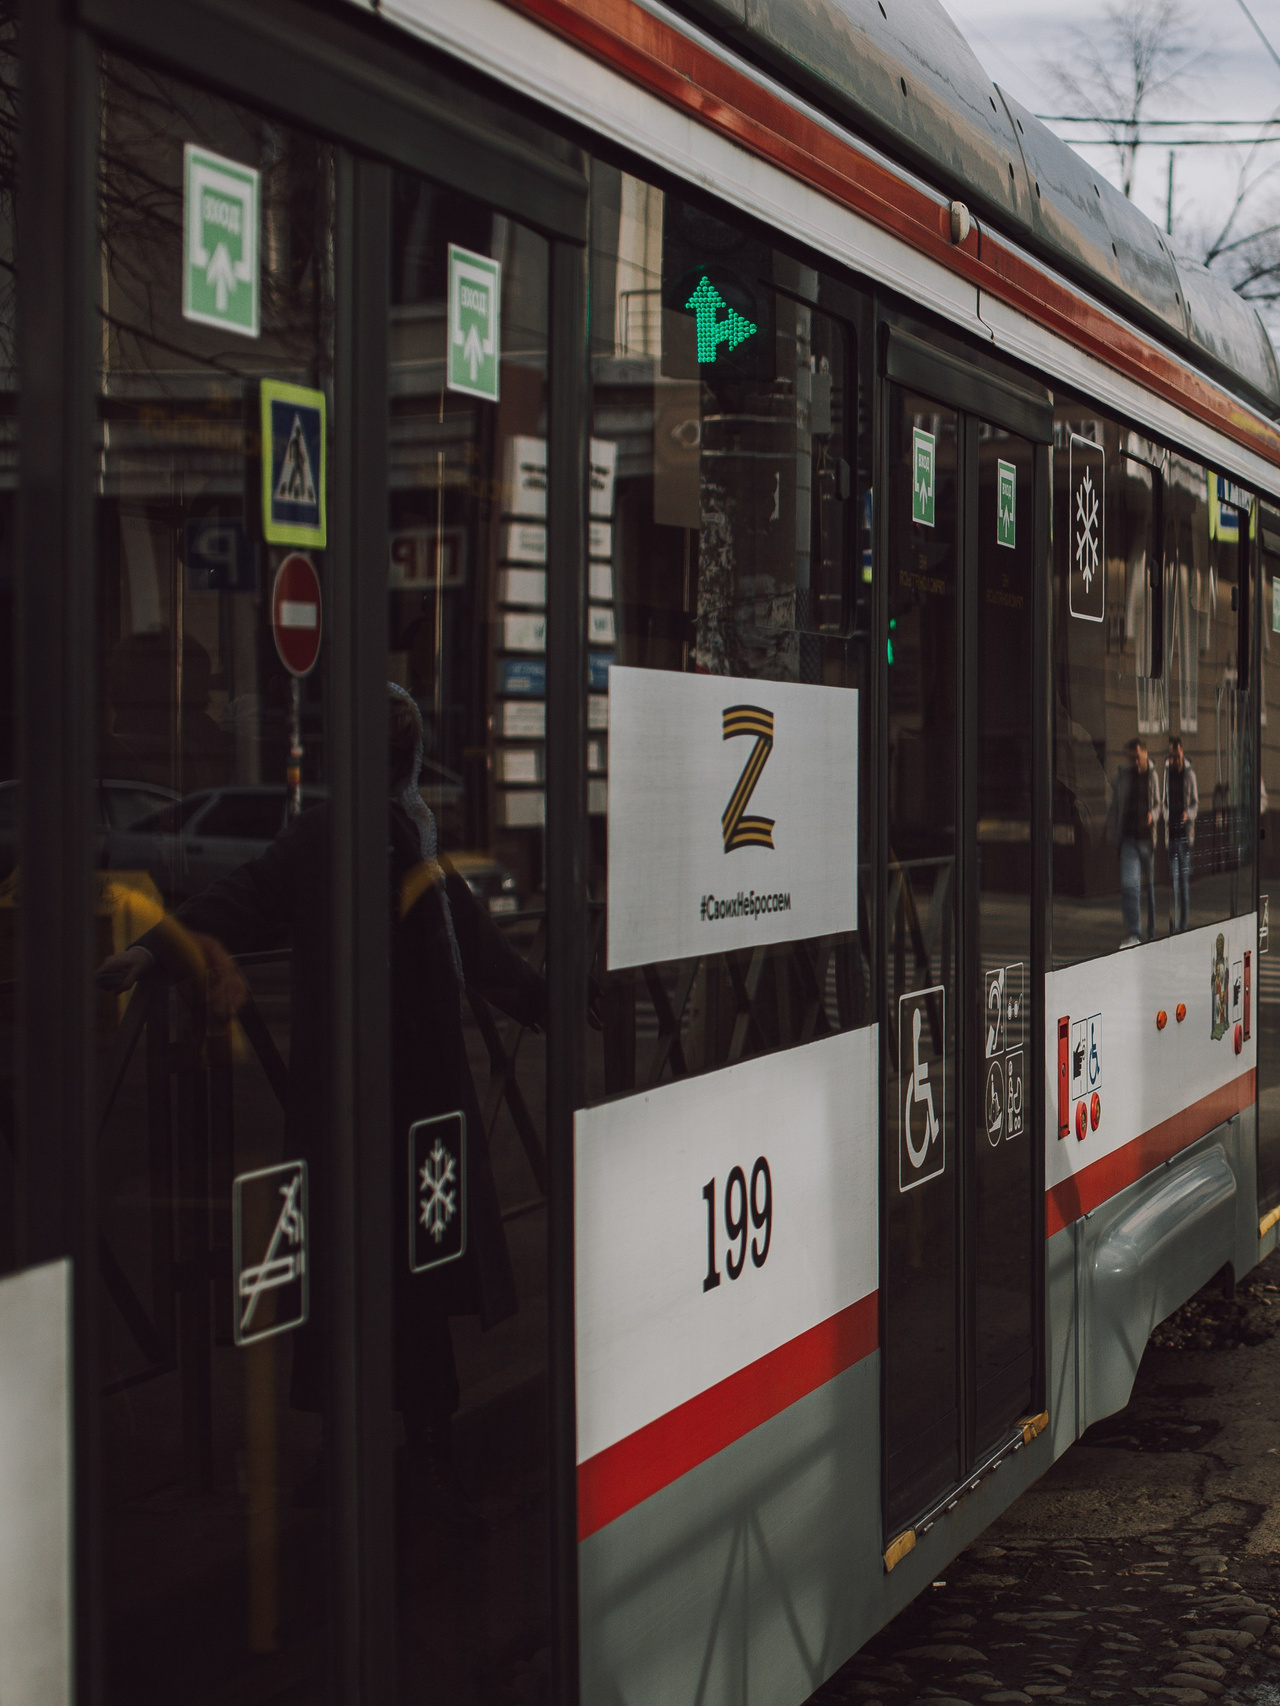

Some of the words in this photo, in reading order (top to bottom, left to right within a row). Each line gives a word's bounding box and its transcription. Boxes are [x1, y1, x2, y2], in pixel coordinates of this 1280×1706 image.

[459, 284, 488, 317] ВХОД
[917, 452, 930, 474] ВХОД
[721, 703, 776, 855] Z
[699, 889, 792, 922] #СвоихНеБросаем
[701, 1154, 774, 1293] 199
